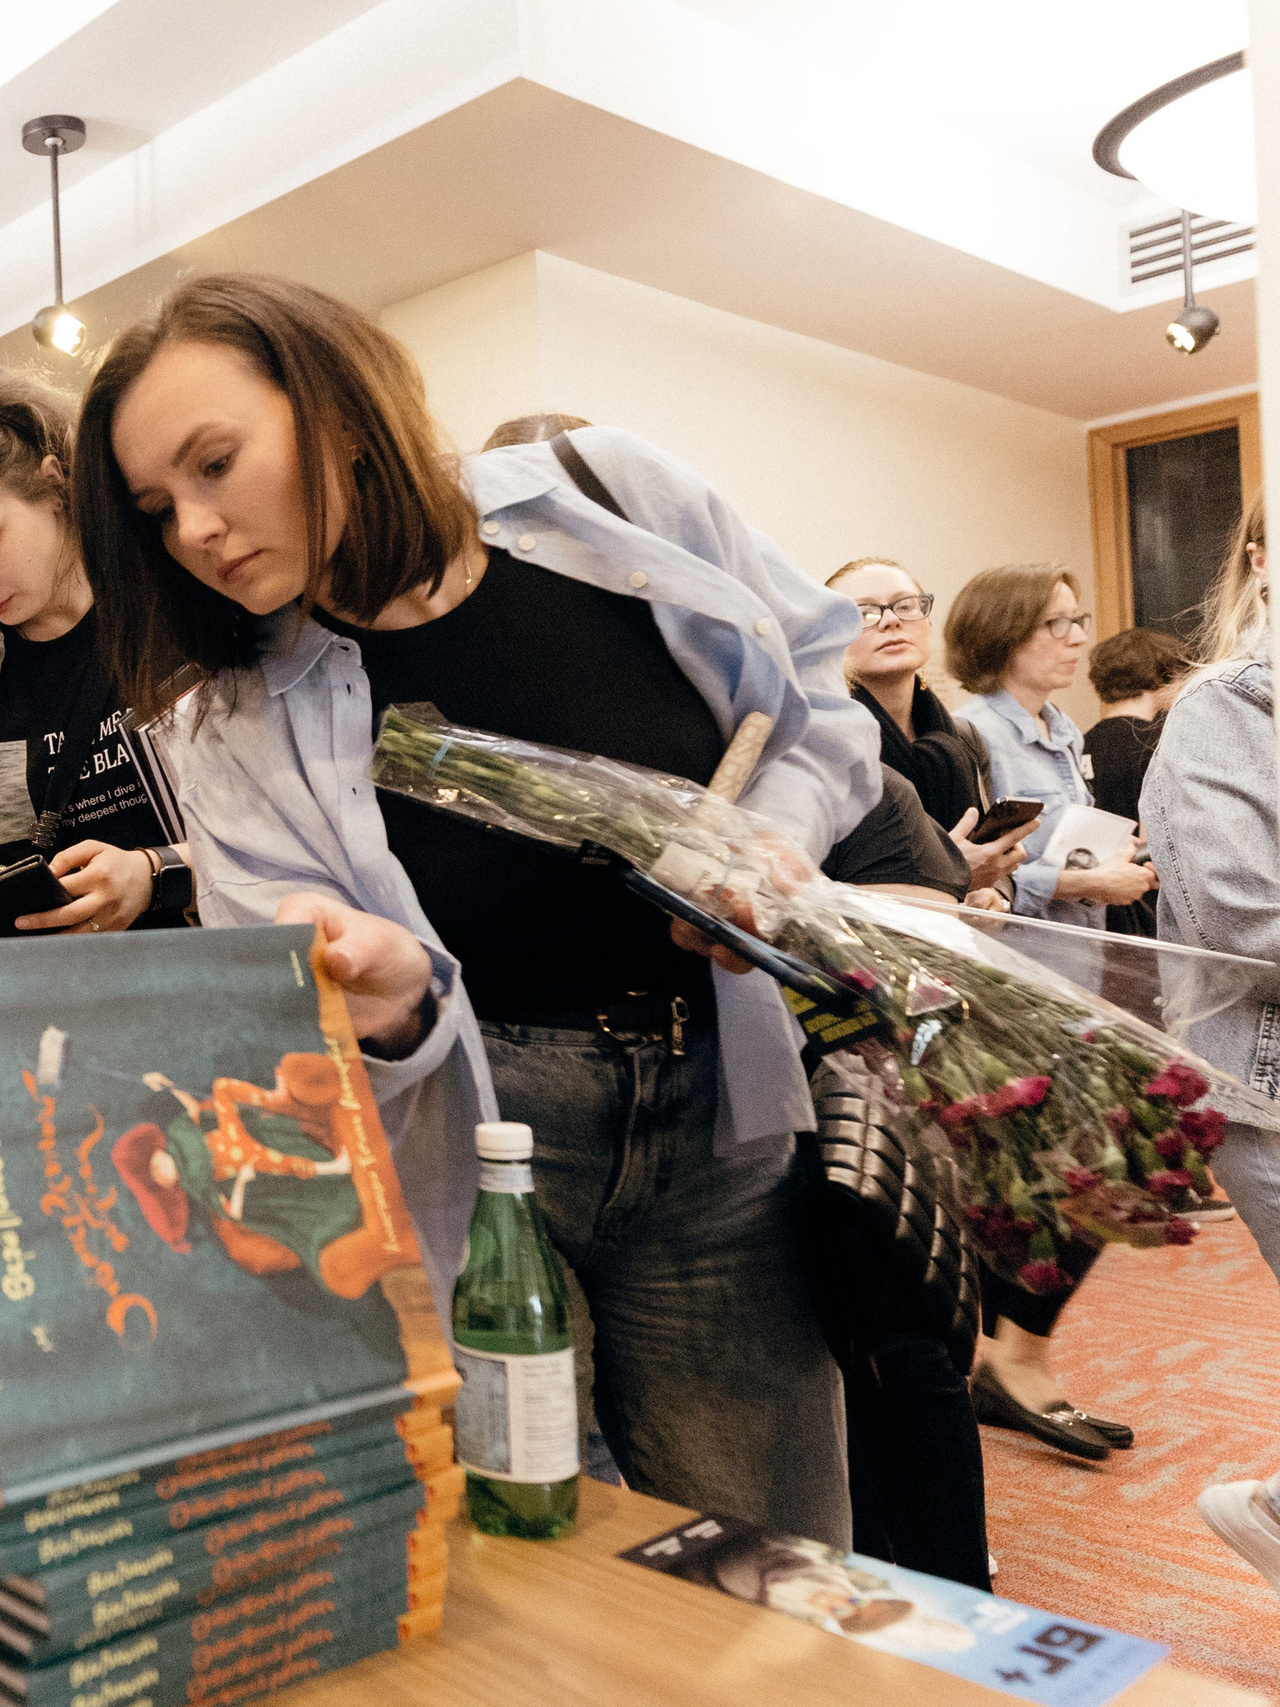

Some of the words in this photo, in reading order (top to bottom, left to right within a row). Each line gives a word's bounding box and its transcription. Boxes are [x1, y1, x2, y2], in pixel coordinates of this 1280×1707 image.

[92, 743, 131, 775] BLA
[61, 817, 76, 828] my
[78, 803, 119, 823] deepest
[119, 793, 148, 810] thoug
[75, 794, 107, 810] where
[107, 790, 112, 799] I
[113, 783, 136, 797] dive
